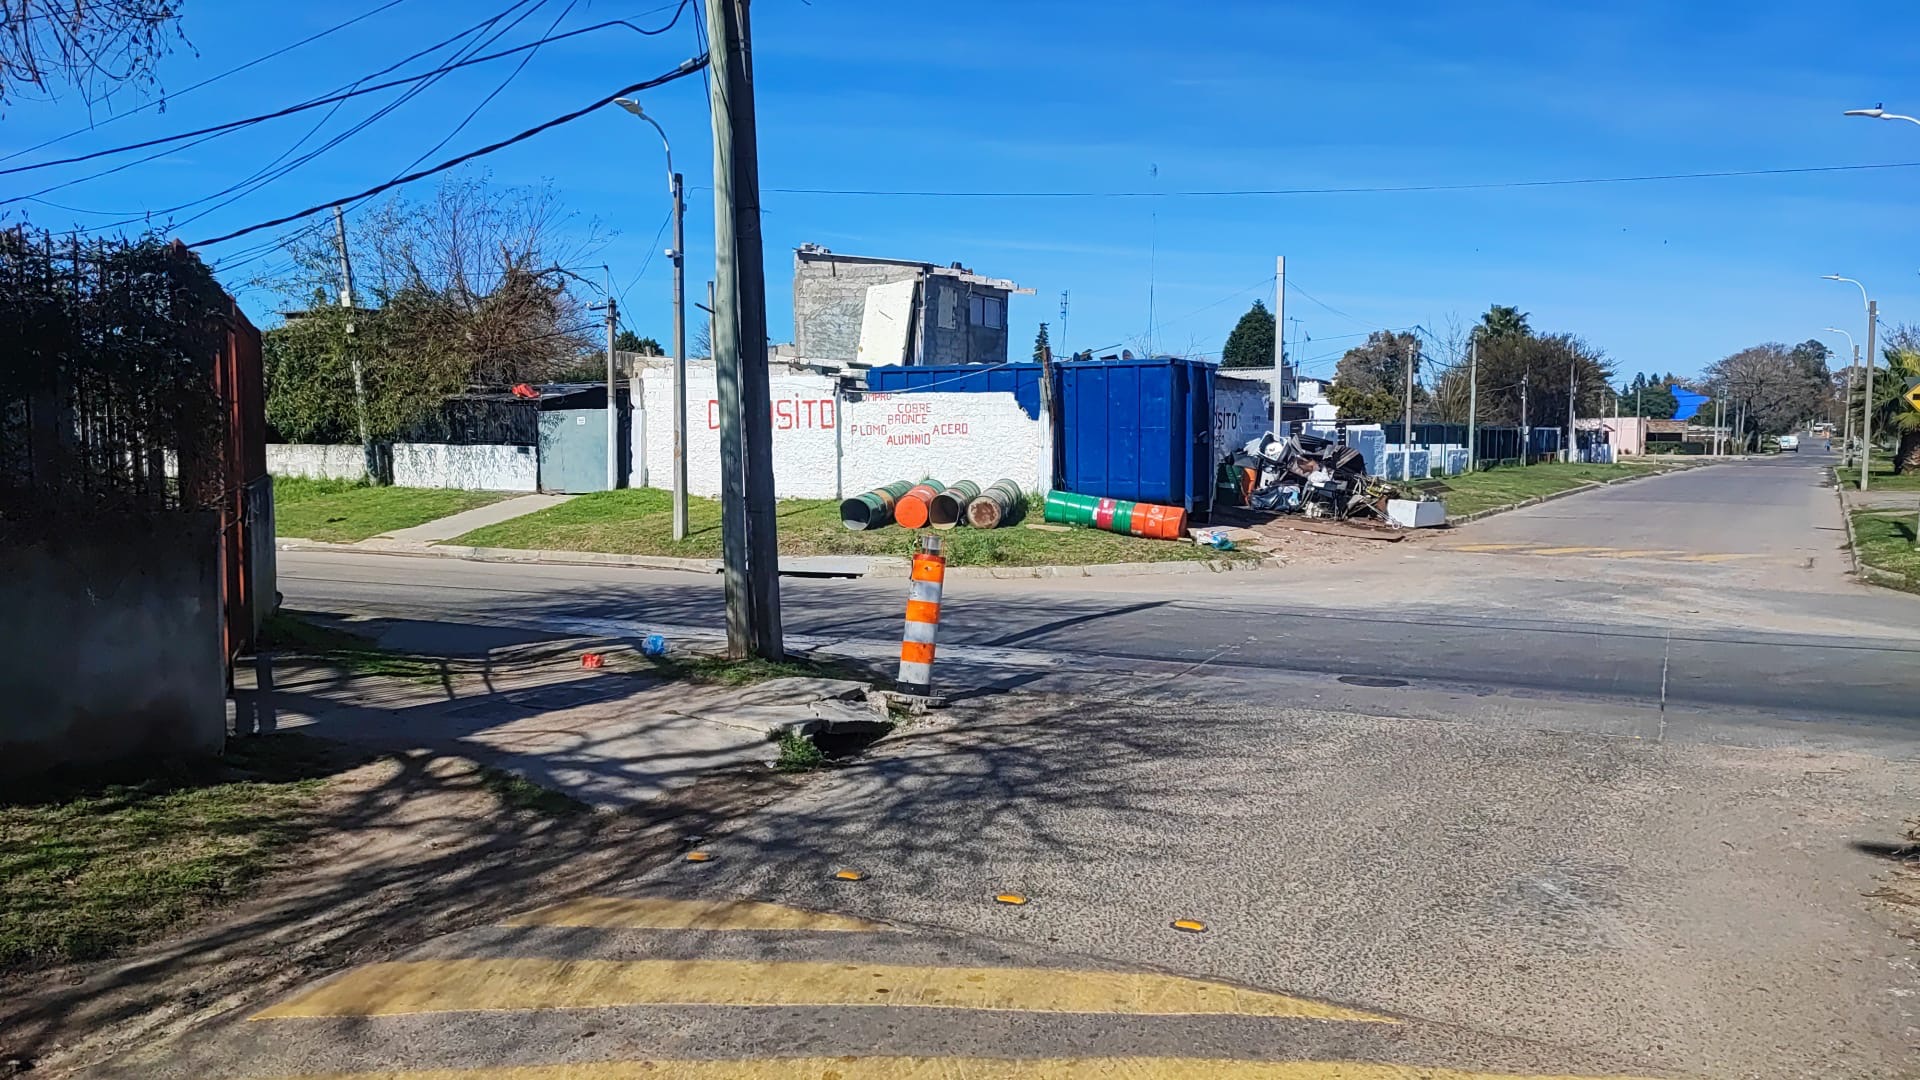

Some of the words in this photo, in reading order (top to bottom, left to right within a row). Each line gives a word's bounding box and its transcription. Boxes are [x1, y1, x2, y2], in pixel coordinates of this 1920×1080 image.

[862, 392, 893, 402] OMPRO
[897, 402, 932, 414] COBRE
[887, 413, 928, 425] BRONCE
[850, 424, 888, 436] PLOMO
[932, 422, 969, 436] ACERO
